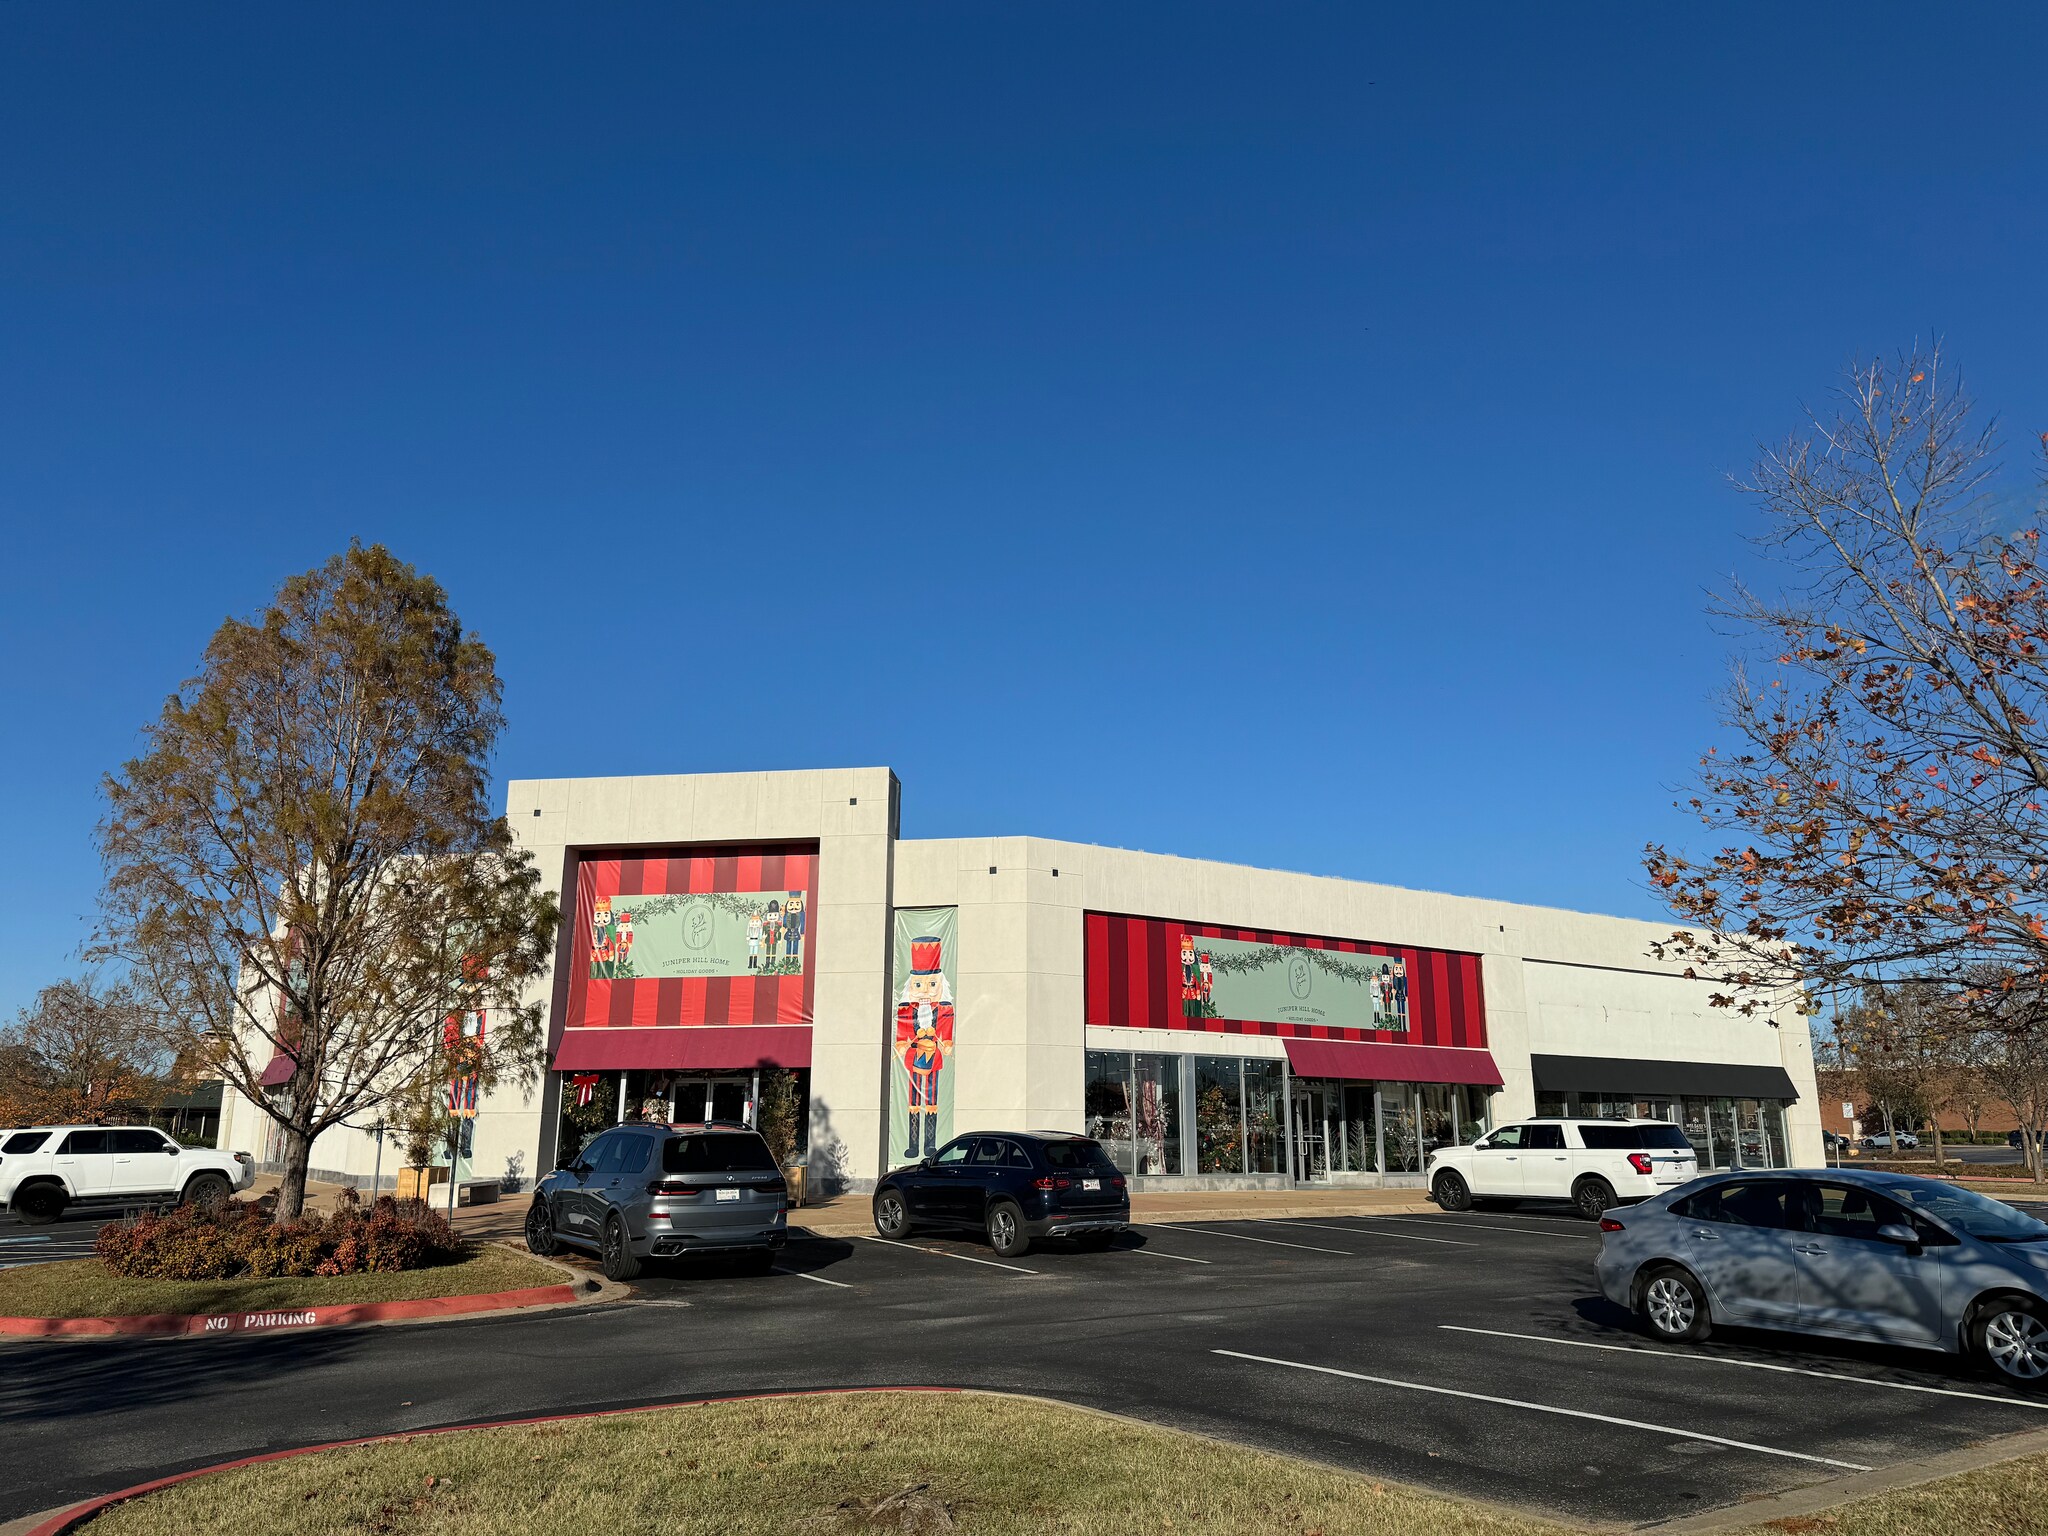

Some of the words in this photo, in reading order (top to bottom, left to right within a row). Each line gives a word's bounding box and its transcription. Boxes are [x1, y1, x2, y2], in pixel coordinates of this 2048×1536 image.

[662, 957, 691, 968] JUNIPER
[710, 957, 730, 966] HOME
[1277, 1005, 1298, 1013] JUNIPER
[1311, 1007, 1326, 1017] HOME
[205, 1316, 229, 1331] NO
[244, 1311, 316, 1328] PARKING
